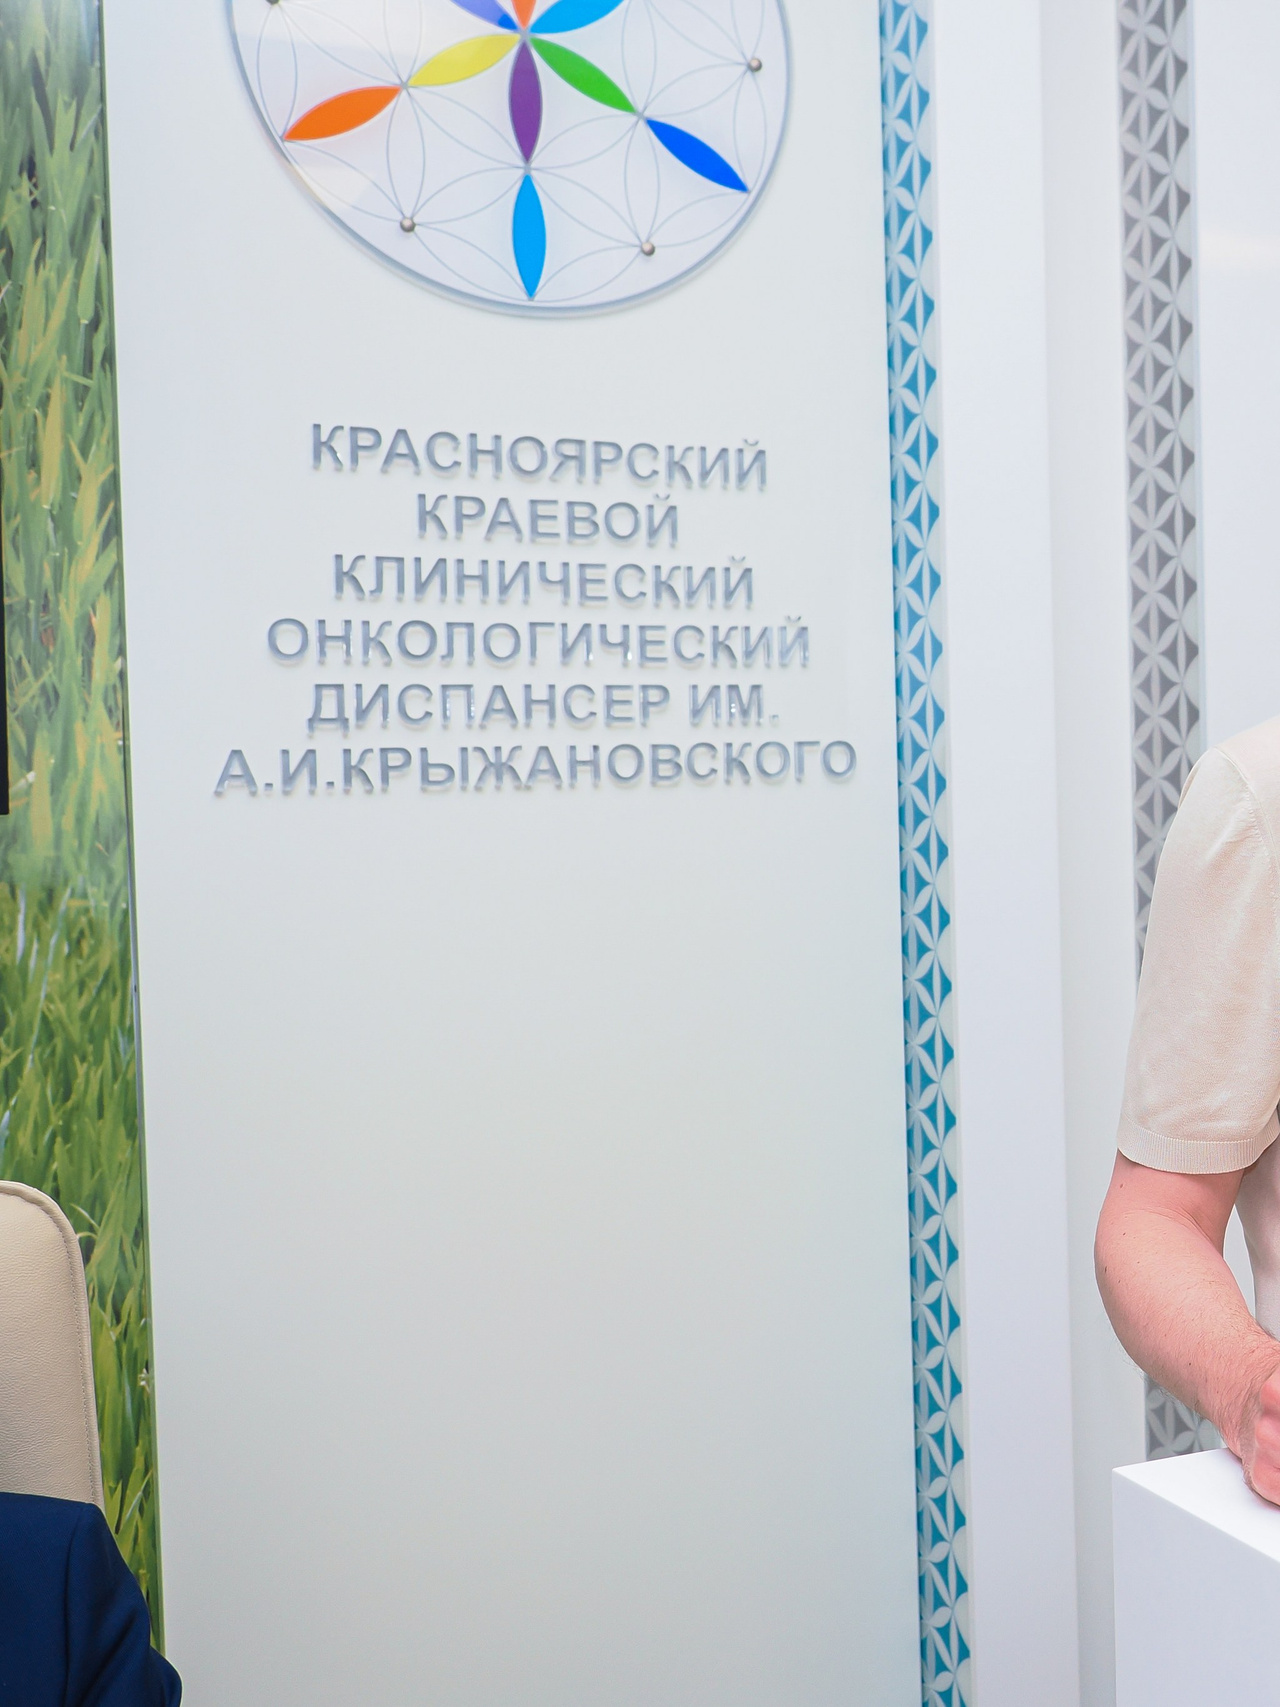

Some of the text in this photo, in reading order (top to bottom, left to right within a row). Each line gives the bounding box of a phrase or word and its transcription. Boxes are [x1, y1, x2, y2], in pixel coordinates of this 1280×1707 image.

[311, 423, 767, 493] КРАСНОЯРСКИЙ
[417, 493, 679, 549] КРАЕВОЙ
[333, 554, 754, 610] КЛИНИЧЕСКИЙ
[267, 616, 810, 670] ОНКОЛОГИЧЕСКИЙ
[307, 683, 780, 739] ДИСПАНСЕР ИМ.
[213, 740, 858, 798] А.И.КРЫЖАНОВСКОГО
